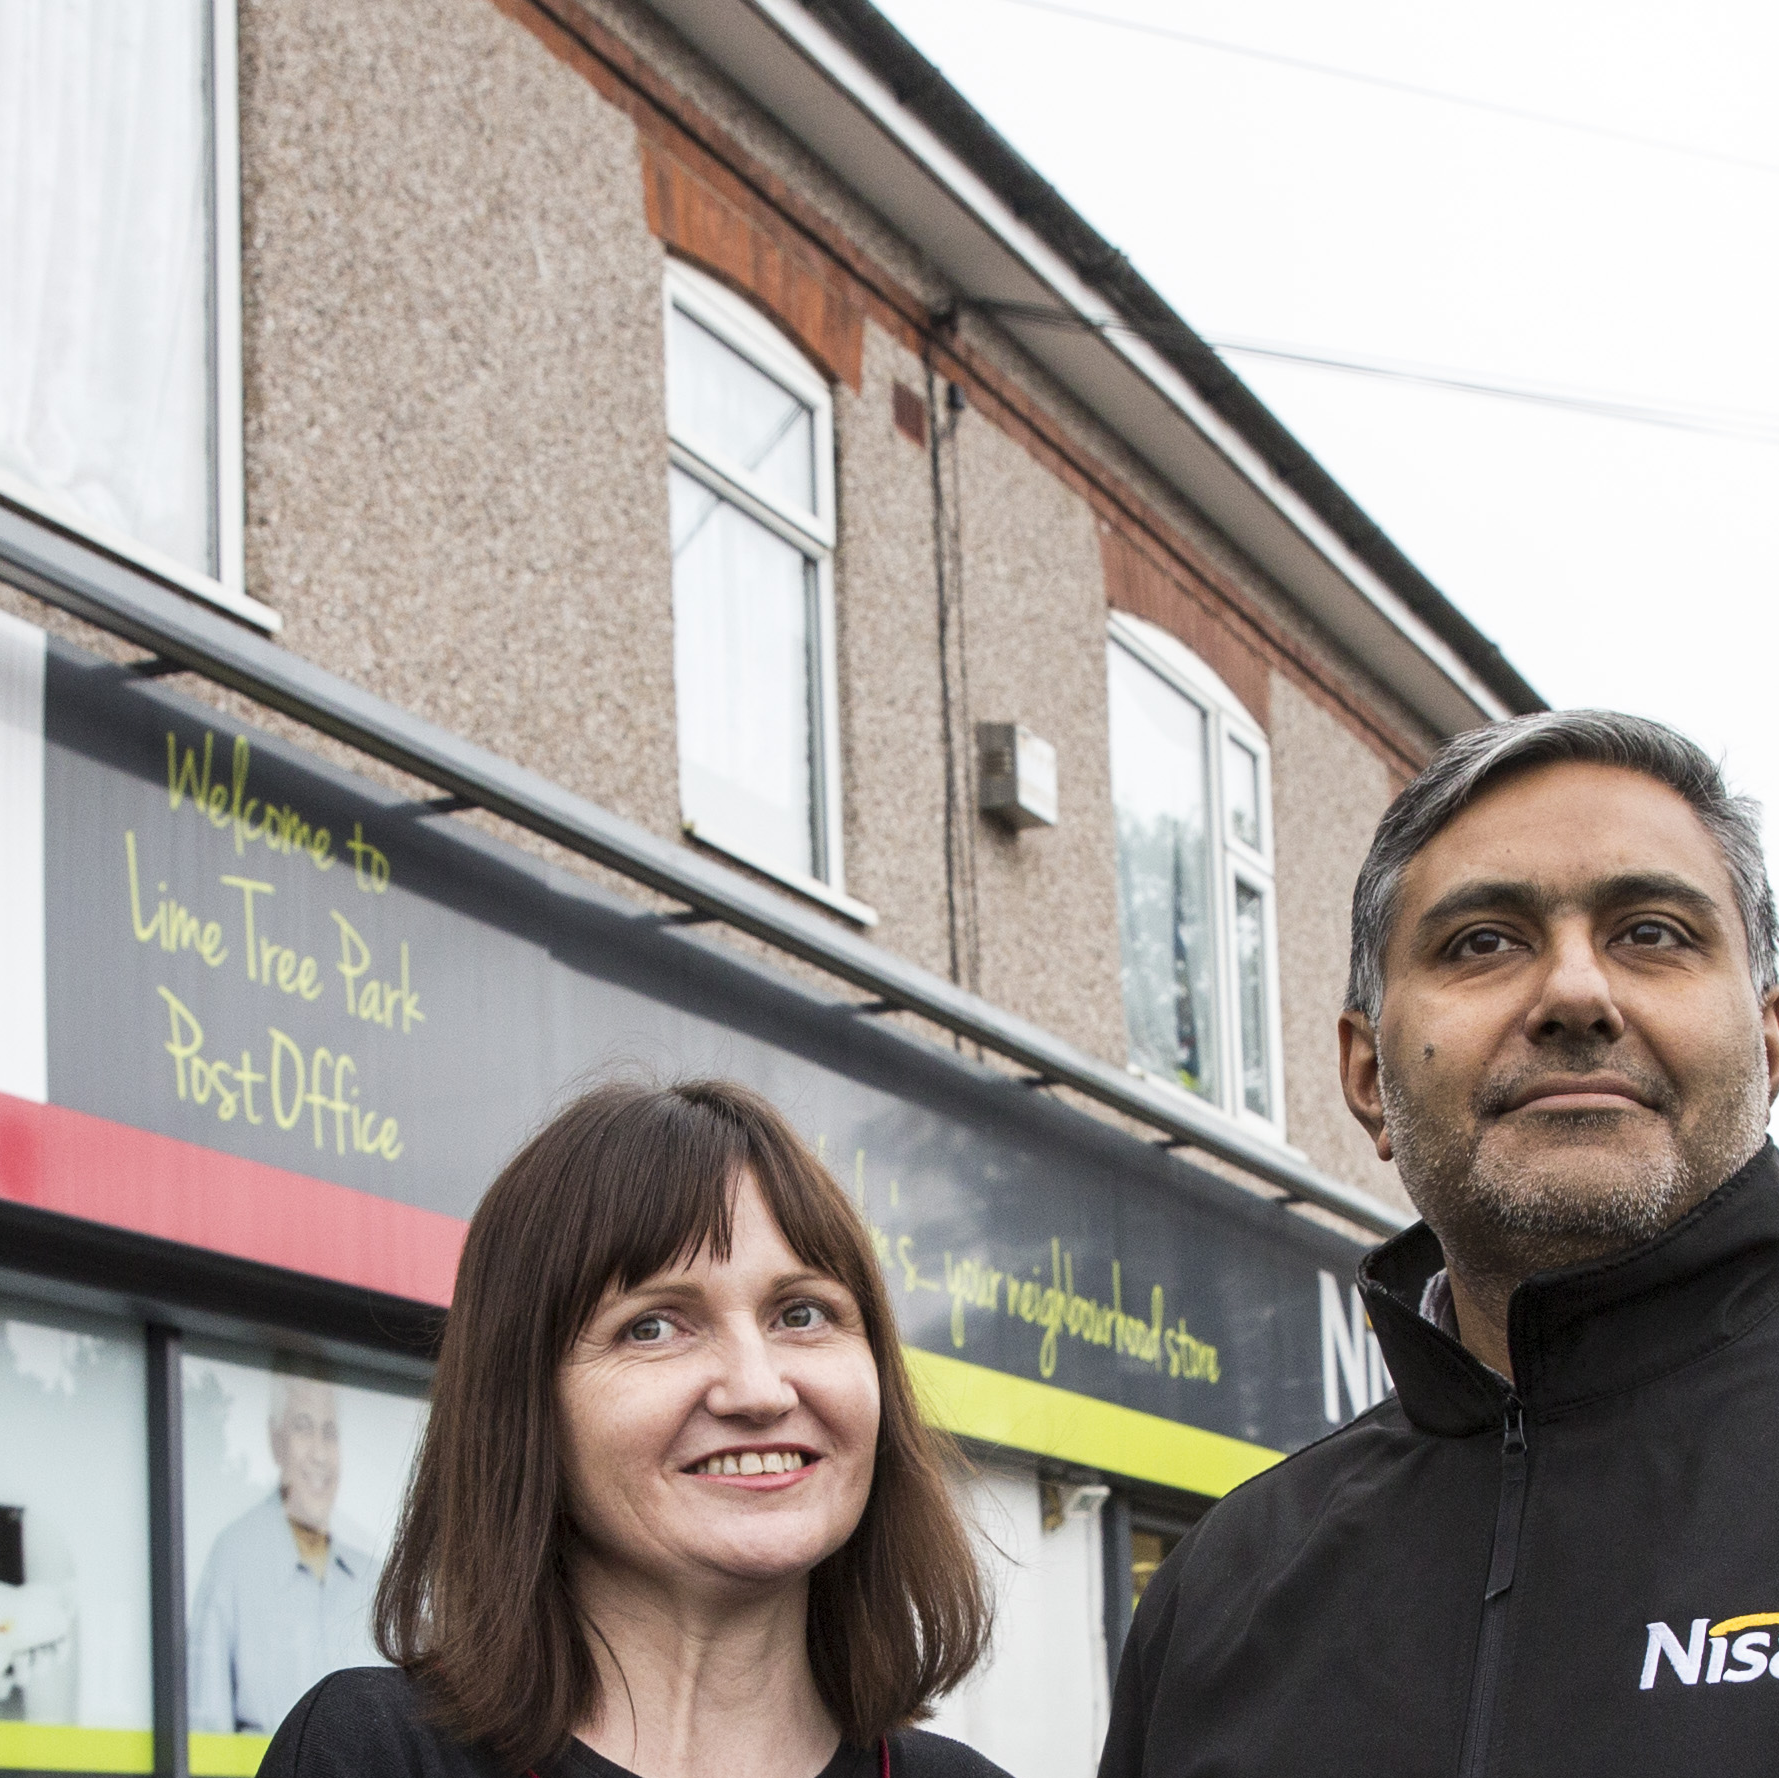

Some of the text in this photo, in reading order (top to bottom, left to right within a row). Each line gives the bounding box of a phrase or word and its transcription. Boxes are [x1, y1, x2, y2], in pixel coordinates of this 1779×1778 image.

[166, 731, 391, 895] Welcome to
[125, 830, 426, 1034] Lime Tree Park
[158, 985, 403, 1161] Post Office
[944, 1236, 1221, 1385] your neighbourhood store
[1317, 1267, 1395, 1424] Ni
